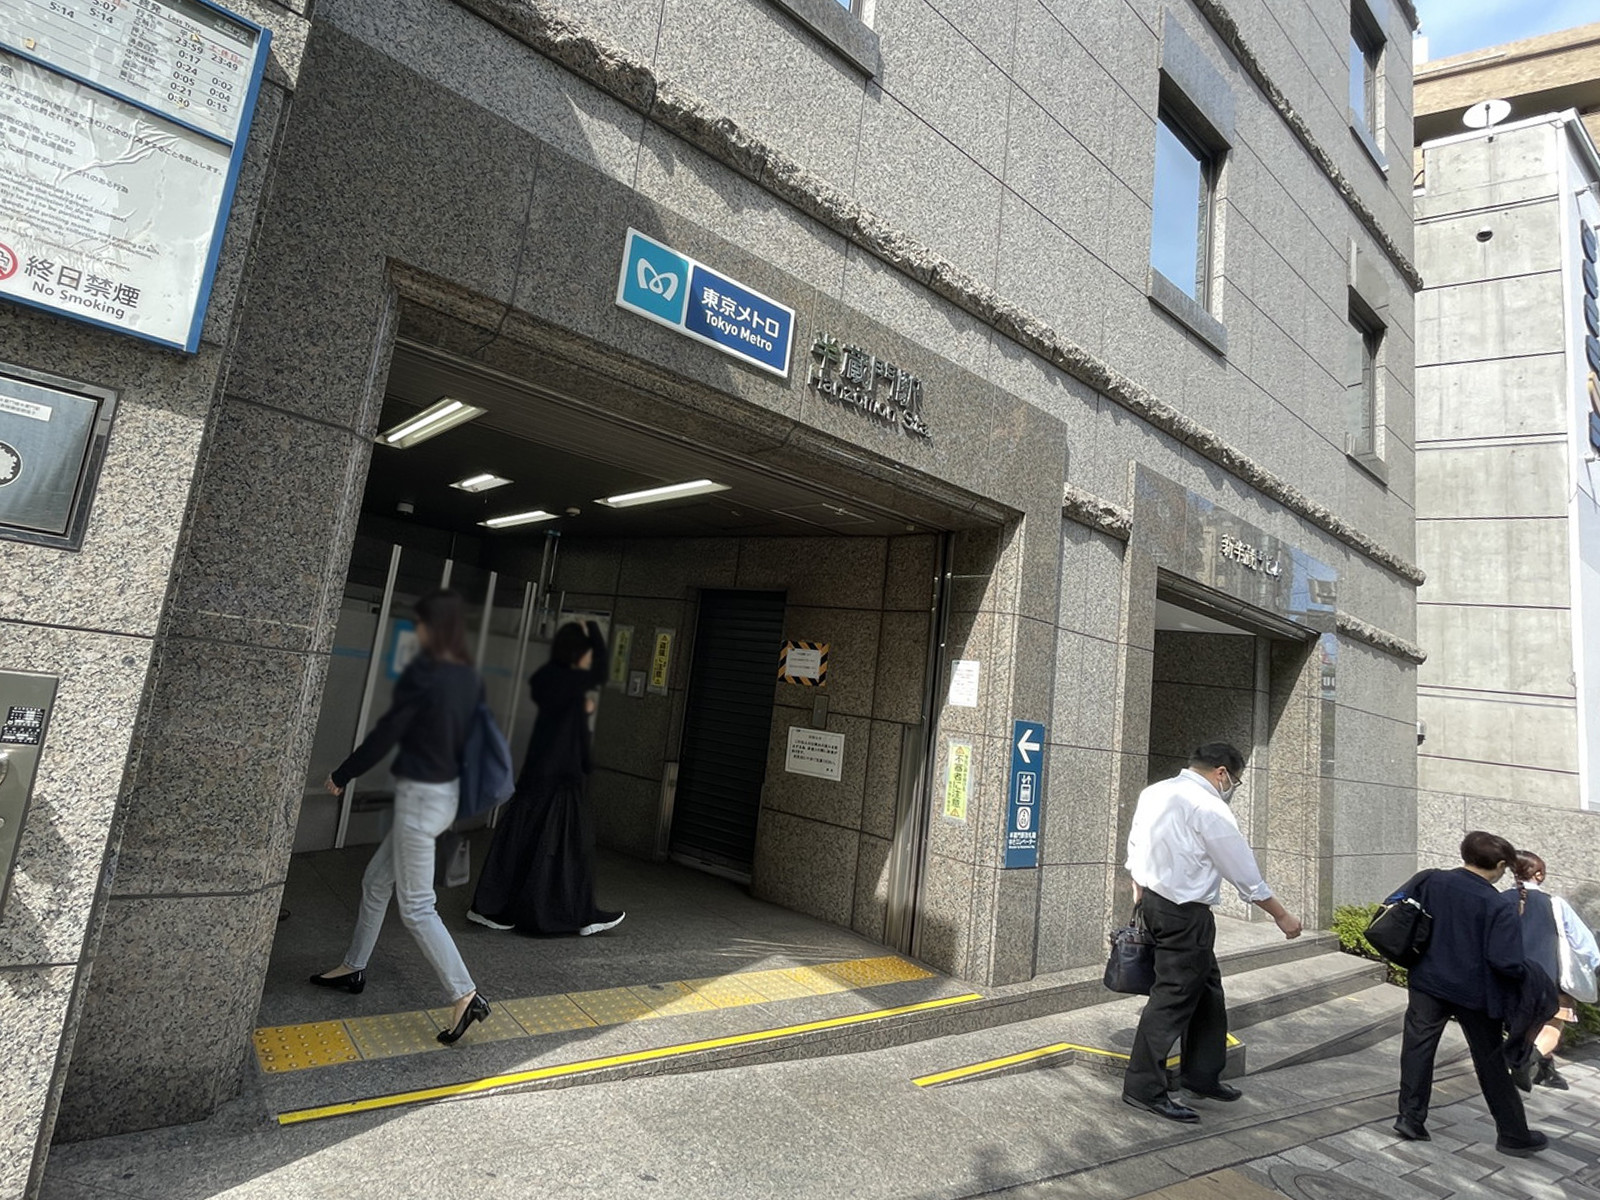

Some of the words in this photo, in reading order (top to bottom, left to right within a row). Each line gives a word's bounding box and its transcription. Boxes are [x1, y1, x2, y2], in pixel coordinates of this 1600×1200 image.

[89, 8, 114, 24] 5:14
[174, 35, 203, 55] 23:59
[210, 52, 238, 71] 23:49
[177, 49, 201, 65] 0:17
[172, 70, 195, 86] 0:05
[209, 87, 230, 102] 0:04
[175, 60, 198, 76] 0:24
[211, 76, 233, 92] 0:02
[169, 81, 192, 97] 0:21
[206, 97, 228, 113] 0:15
[24, 254, 141, 309] 終日禁煙
[32, 281, 55, 297] No
[59, 288, 126, 320] Smoking
[702, 286, 780, 339] 東京メトロ
[705, 310, 739, 337] Tokyo
[740, 327, 773, 352] Metro
